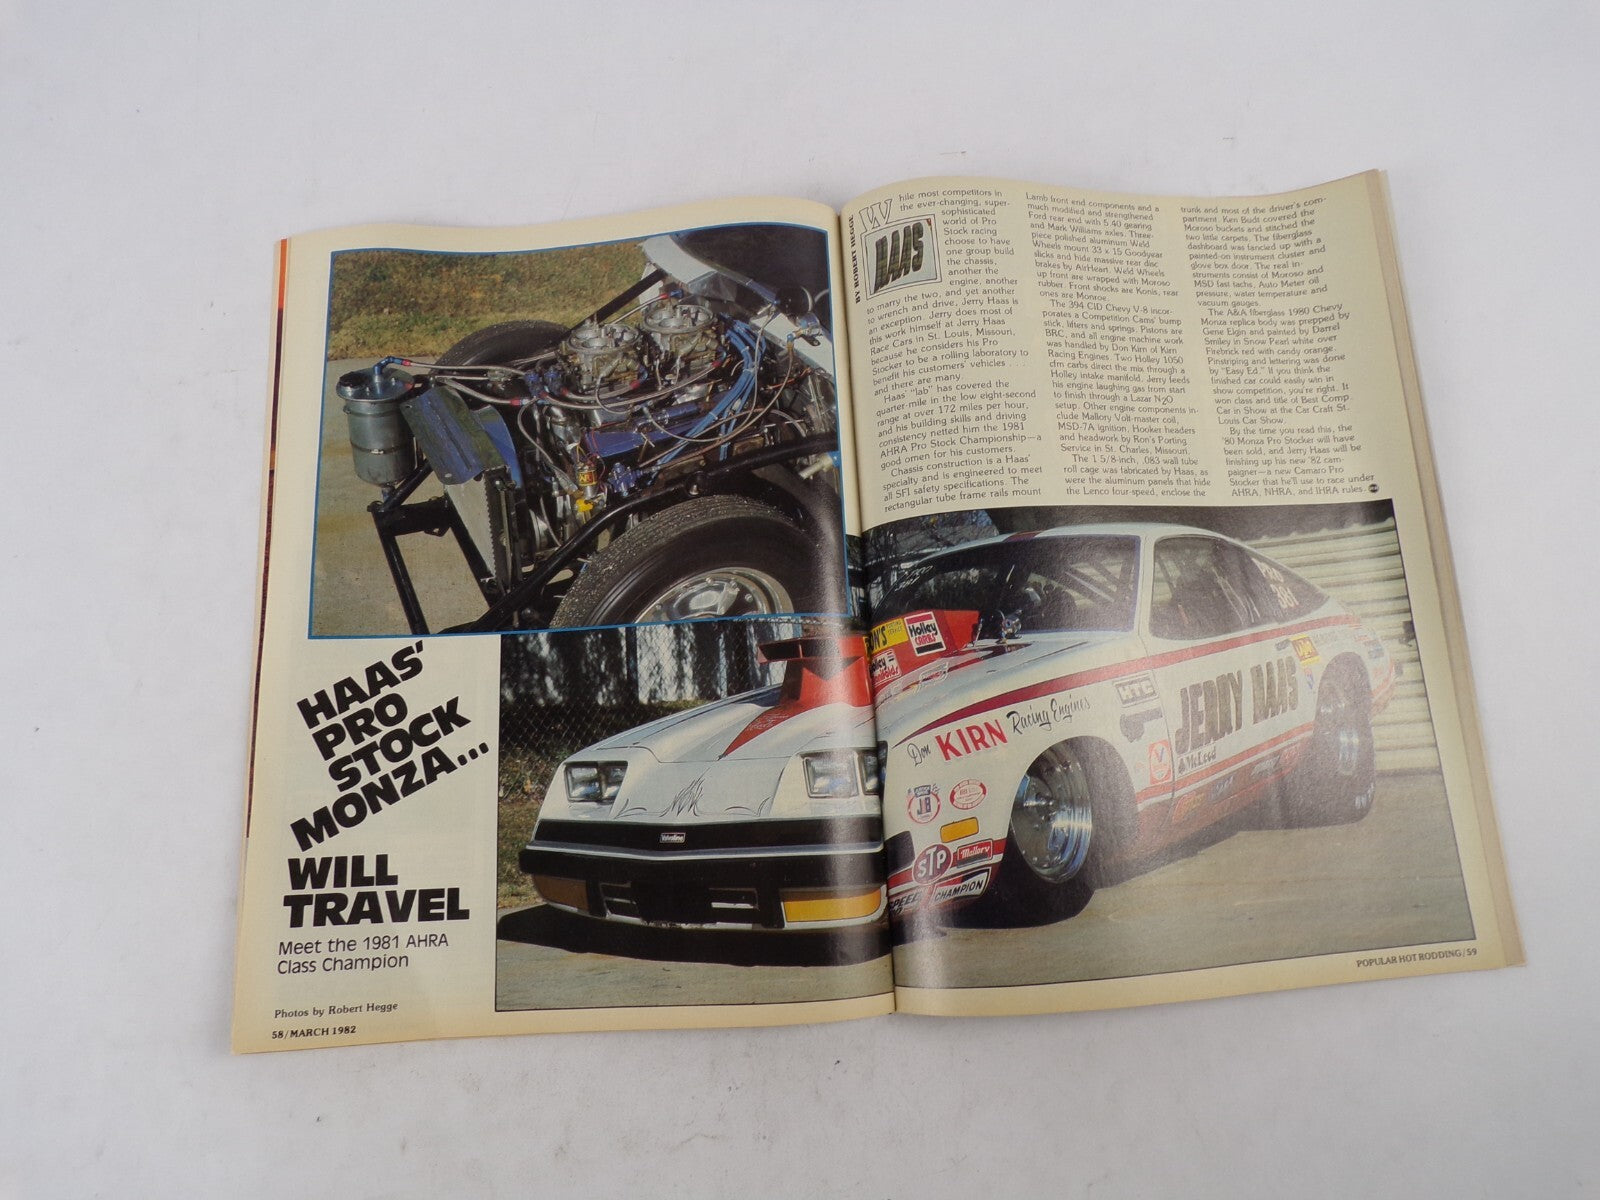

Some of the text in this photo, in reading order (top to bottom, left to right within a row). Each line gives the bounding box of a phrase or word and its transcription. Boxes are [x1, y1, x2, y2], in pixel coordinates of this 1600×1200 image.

[917, 190, 940, 198] most
[941, 189, 993, 199] competitors
[994, 189, 1003, 197] in
[942, 216, 998, 225] world of Pro
[943, 226, 998, 236] Stock racing
[944, 236, 1011, 245] choose to have
[965, 249, 992, 257] group
[993, 246, 1016, 255] build
[851, 250, 859, 288] ROBERT
[854, 291, 861, 304] BY
[1051, 299, 1067, 308] The
[1068, 300, 1085, 309] 394
[1086, 301, 1104, 310] CID
[1105, 303, 1132, 315] Chevy
[1132, 305, 1149, 314] V-8
[1207, 308, 1225, 316] The
[1288, 306, 1311, 316] 1980
[1312, 304, 1344, 313] Chevy
[1202, 327, 1225, 336] Gene
[1249, 327, 1266, 336] and
[1266, 327, 1297, 338] painted
[1298, 327, 1310, 337] by
[1047, 349, 1077, 361] Racing
[1113, 353, 1133, 362] Two
[1134, 354, 1161, 365] Holley
[1163, 355, 1184, 364] 1050
[1207, 356, 1250, 367] Pinstriping
[1251, 356, 1268, 365] and
[1268, 356, 1302, 366] lettering
[1322, 354, 1347, 363] done
[1050, 369, 1078, 381] Holley
[1080, 371, 1105, 380] intake
[1146, 374, 1167, 385] Jerry
[1168, 375, 1191, 384] feeds
[1051, 380, 1065, 388] his
[1066, 382, 1094, 391] engine
[1096, 382, 1131, 394] laughing
[1132, 386, 1146, 394] gas
[1147, 384, 1167, 393] from
[1212, 386, 1234, 394] show
[1341, 382, 1350, 391] It
[876, 416, 900, 427] range
[902, 411, 912, 420] at
[913, 409, 935, 417] over
[938, 404, 957, 414] 172
[959, 403, 984, 412] miles
[986, 404, 1002, 412] per
[1056, 411, 1080, 420] clude
[878, 422, 1025, 447] consistency netted him the 1981
[1057, 422, 1096, 431] MSD-7A
[1164, 426, 1197, 434] headers
[1060, 443, 1092, 452] Service
[1094, 444, 1103, 452] in
[880, 457, 902, 470] good
[904, 454, 931, 462] omen
[933, 450, 947, 458] for
[949, 448, 964, 456] his
[890, 464, 925, 476] Chassis
[926, 458, 984, 470] construction
[985, 457, 996, 465] is
[884, 487, 1042, 512] rectangular tube frame rails mount
[1298, 487, 1314, 496] and
[908, 622, 938, 637] Holley
[296, 639, 424, 729] HAAS'
[311, 692, 408, 761] PRO
[907, 694, 1091, 766] Don KIRN Racing Engines
[328, 696, 472, 792] STOCK
[290, 742, 489, 852] MONZA...
[917, 845, 947, 878] STP
[287, 854, 399, 890] WILL
[934, 880, 984, 901] CHAMPION
[283, 887, 470, 928] TRAVEL
[278, 933, 449, 956] Meet the 1981 AHRA
[277, 954, 409, 975] Class Champion
[1356, 956, 1398, 968] POPULAR
[1398, 954, 1417, 963] HOT
[273, 1002, 398, 1019] Photos by Robert Hegge
[332, 1025, 357, 1035] 1982
